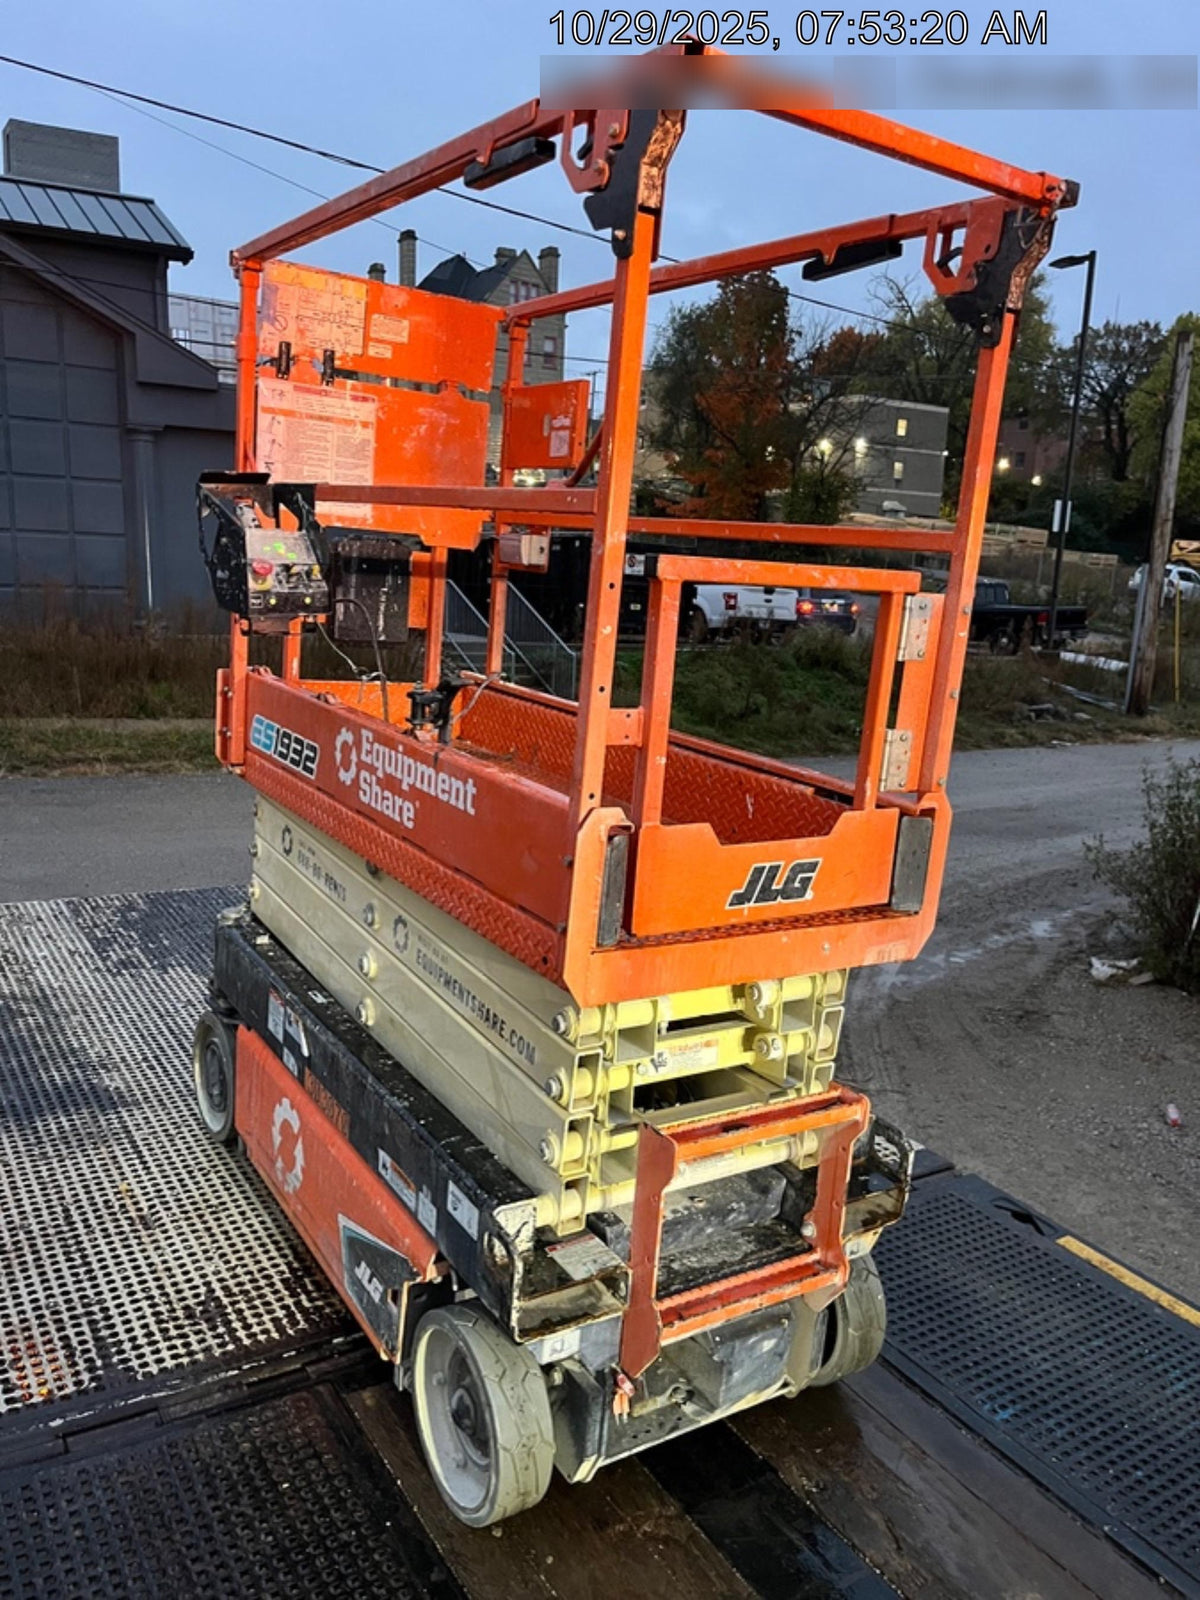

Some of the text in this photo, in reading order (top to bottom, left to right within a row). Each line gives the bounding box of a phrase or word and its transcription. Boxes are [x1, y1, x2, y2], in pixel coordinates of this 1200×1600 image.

[250, 714, 319, 779] ES1932
[360, 728, 477, 816] Equipment
[725, 857, 823, 910] JLG
[415, 948, 537, 1066] EQUIPMENTSHARE.COM
[354, 1260, 384, 1304] JLG
